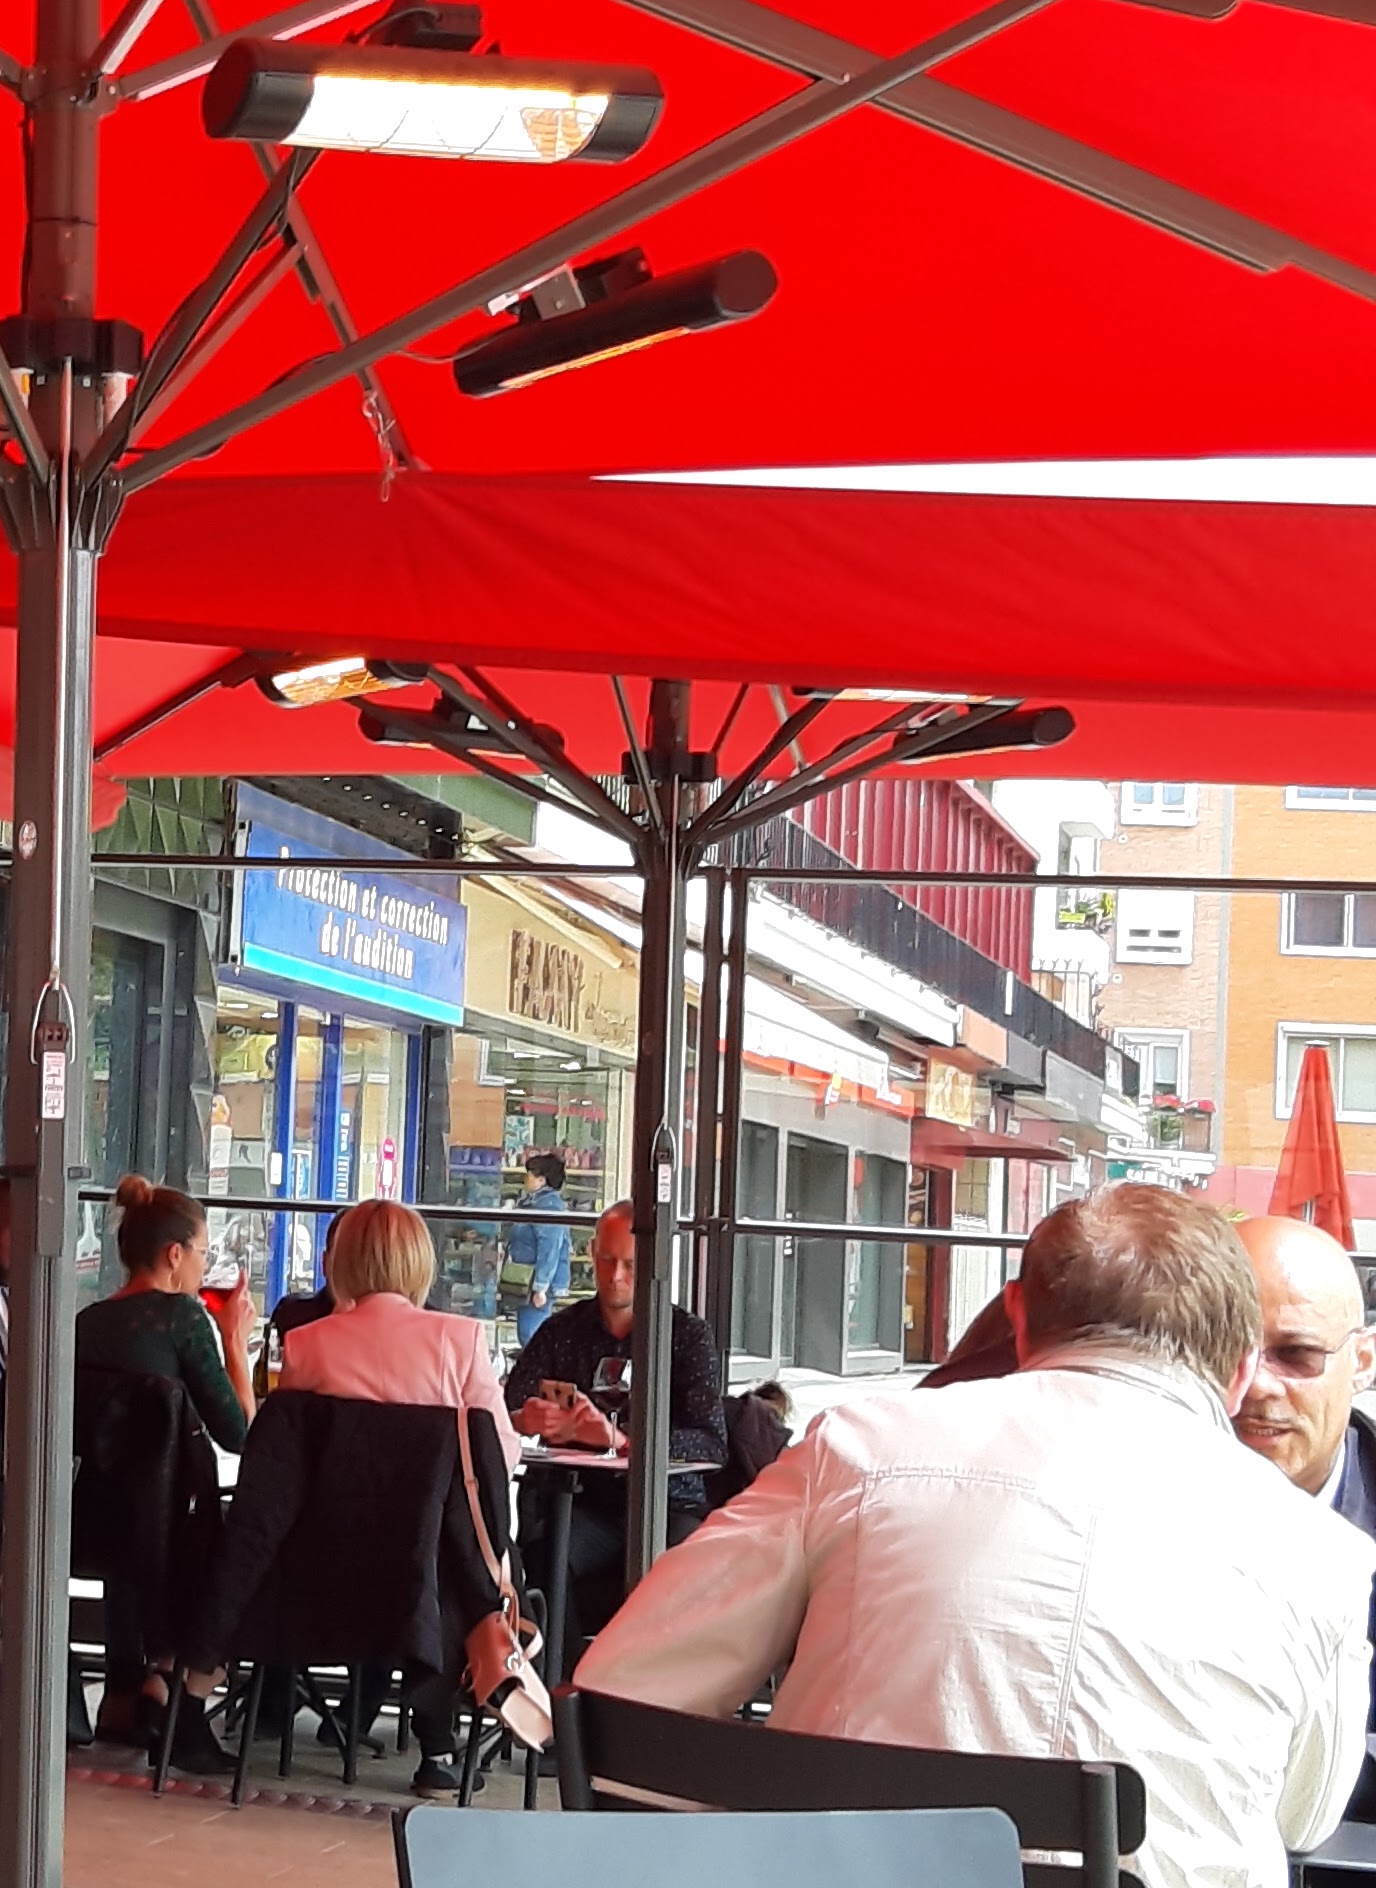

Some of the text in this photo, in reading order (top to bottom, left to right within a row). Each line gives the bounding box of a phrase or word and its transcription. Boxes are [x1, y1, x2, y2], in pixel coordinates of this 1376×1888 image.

[277, 846, 449, 946] Protection et correction
[319, 911, 414, 979] de l'audition
